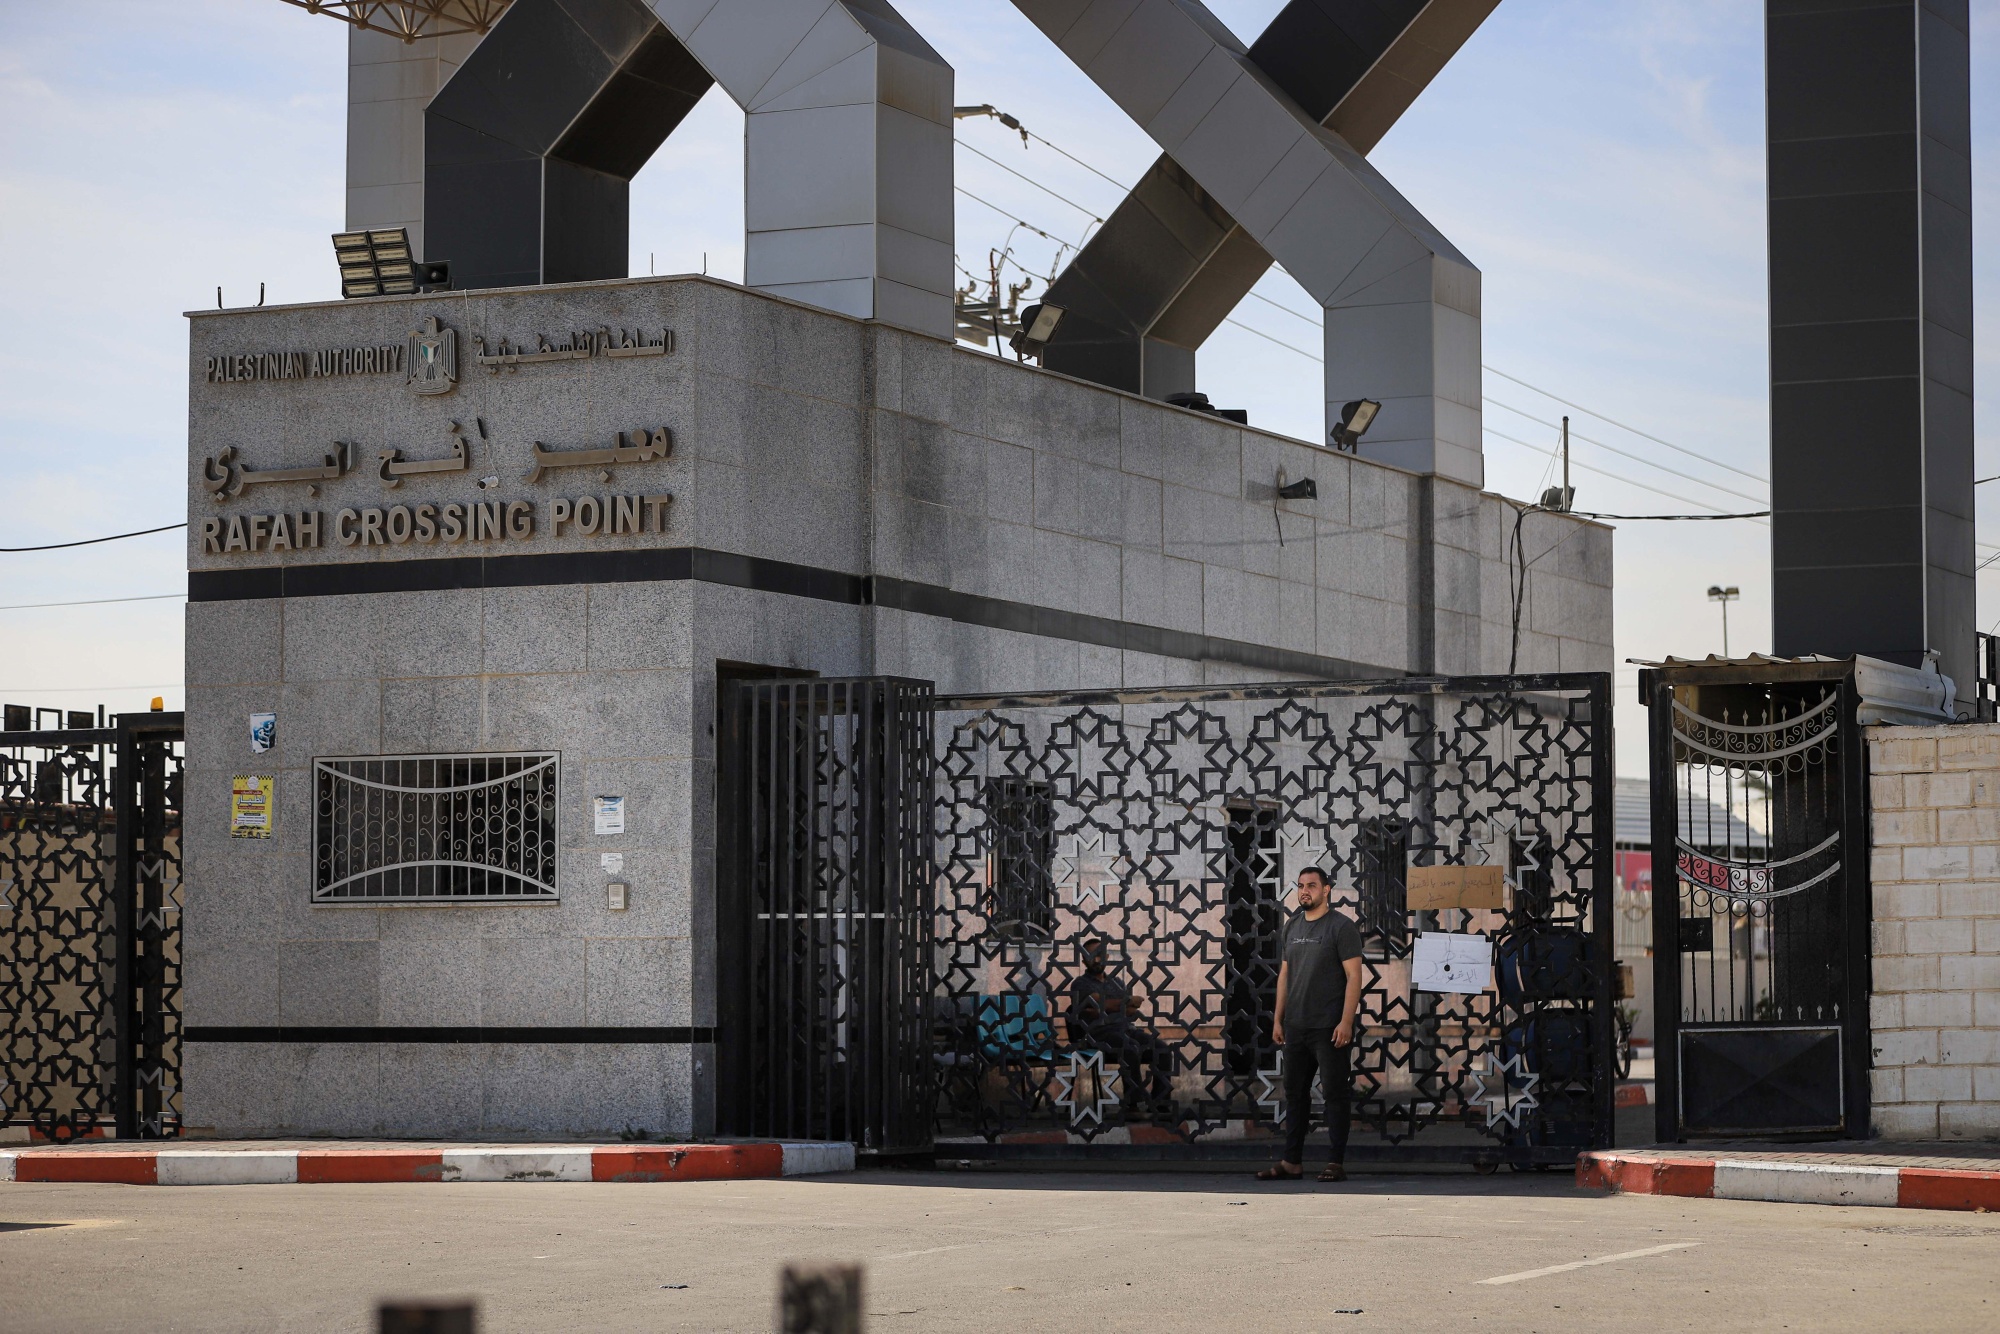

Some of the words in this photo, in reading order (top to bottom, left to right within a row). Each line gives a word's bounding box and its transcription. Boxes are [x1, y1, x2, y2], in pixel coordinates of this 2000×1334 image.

[205, 351, 304, 383] PALESTINIAN
[312, 344, 402, 379] AUTHORITY
[474, 329, 598, 375] الفلسطينية
[601, 325, 673, 357] السلطة
[204, 440, 357, 501] البري
[523, 426, 672, 483] معبر
[203, 510, 323, 554] RAFAH
[335, 501, 536, 546] CROSSING
[549, 493, 673, 537] POINT
[237, 795, 265, 806] الطيار
